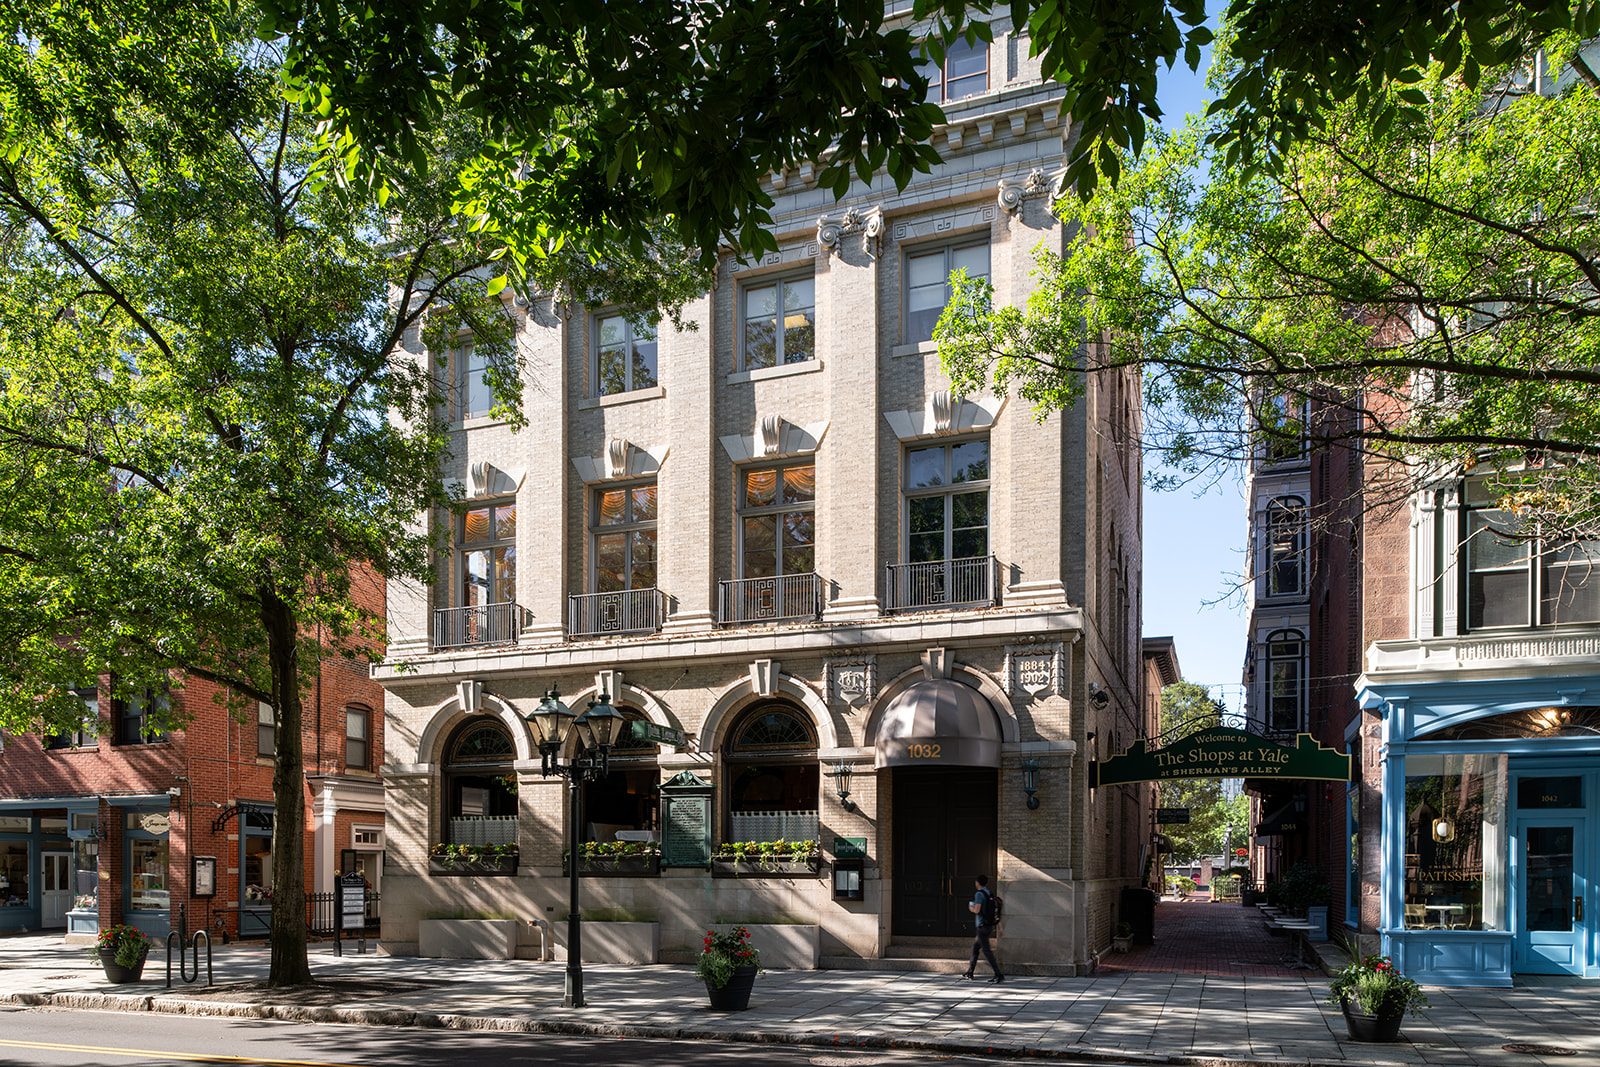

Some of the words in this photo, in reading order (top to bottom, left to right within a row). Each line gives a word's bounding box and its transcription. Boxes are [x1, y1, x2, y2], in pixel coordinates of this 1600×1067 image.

[1020, 660, 1046, 671] 1884
[1020, 672, 1044, 684] 1902
[1195, 733, 1236, 744] Welcome
[1237, 735, 1247, 743] to
[907, 744, 941, 758] 1032
[1154, 752, 1184, 766] The
[1188, 748, 1235, 765] Shops
[1239, 750, 1254, 761] at
[1258, 748, 1289, 763] Yale
[1172, 767, 1239, 776] SHERMAN'S
[1241, 766, 1281, 774] ALLEY
[1281, 823, 1296, 831] 1044
[1418, 871, 1492, 881] PATISSERIE
